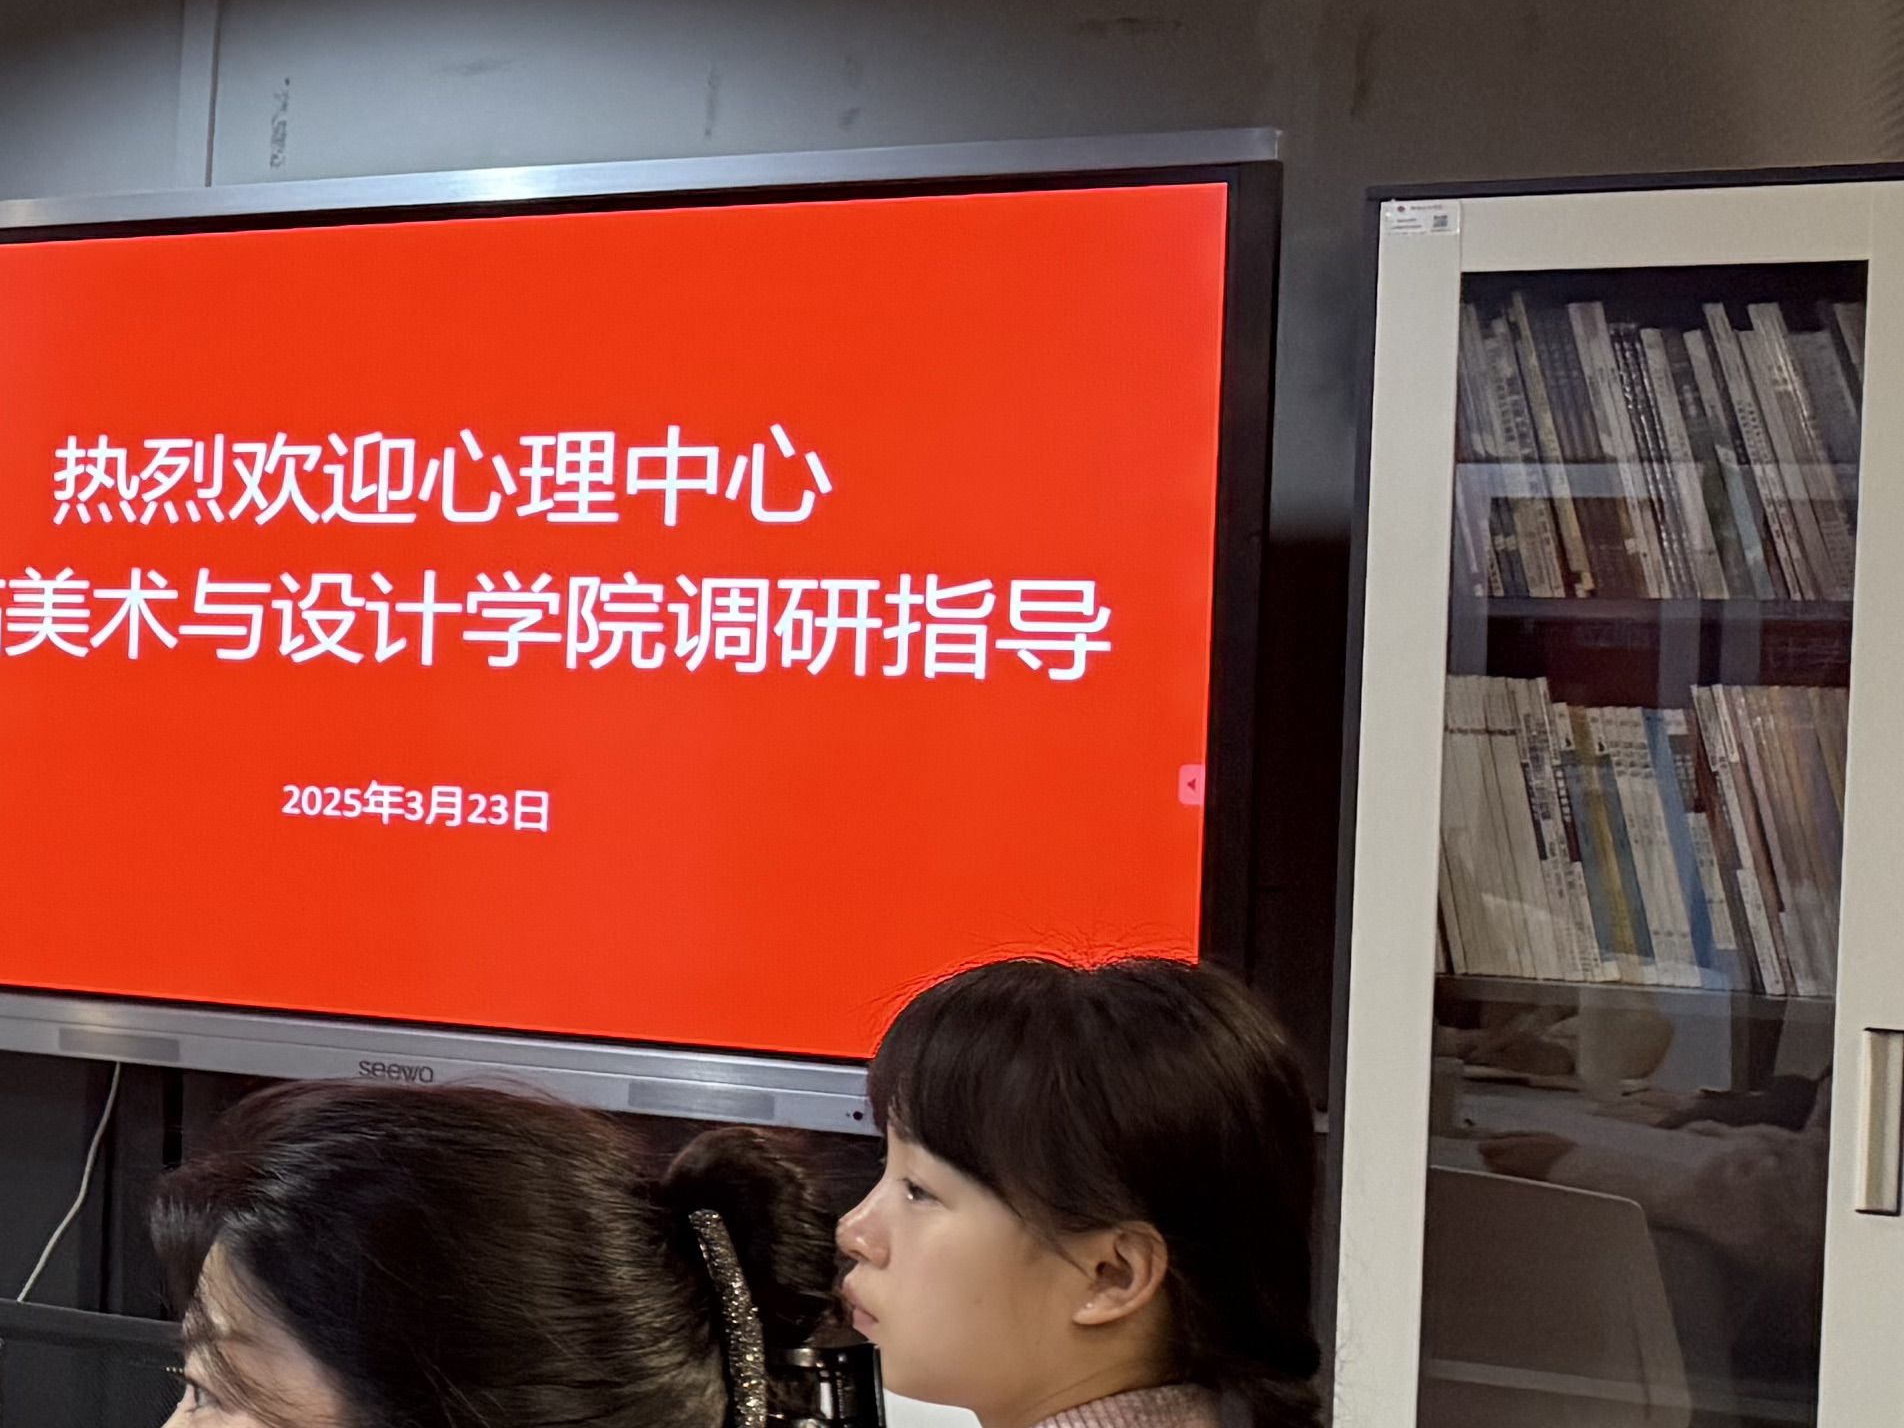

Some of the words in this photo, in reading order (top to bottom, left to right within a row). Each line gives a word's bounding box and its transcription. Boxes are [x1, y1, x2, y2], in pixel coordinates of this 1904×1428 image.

[53, 424, 833, 527] 热烈欢迎心理中心
[282, 780, 549, 832] 2025年3月23日
[358, 1060, 434, 1083] seewo
